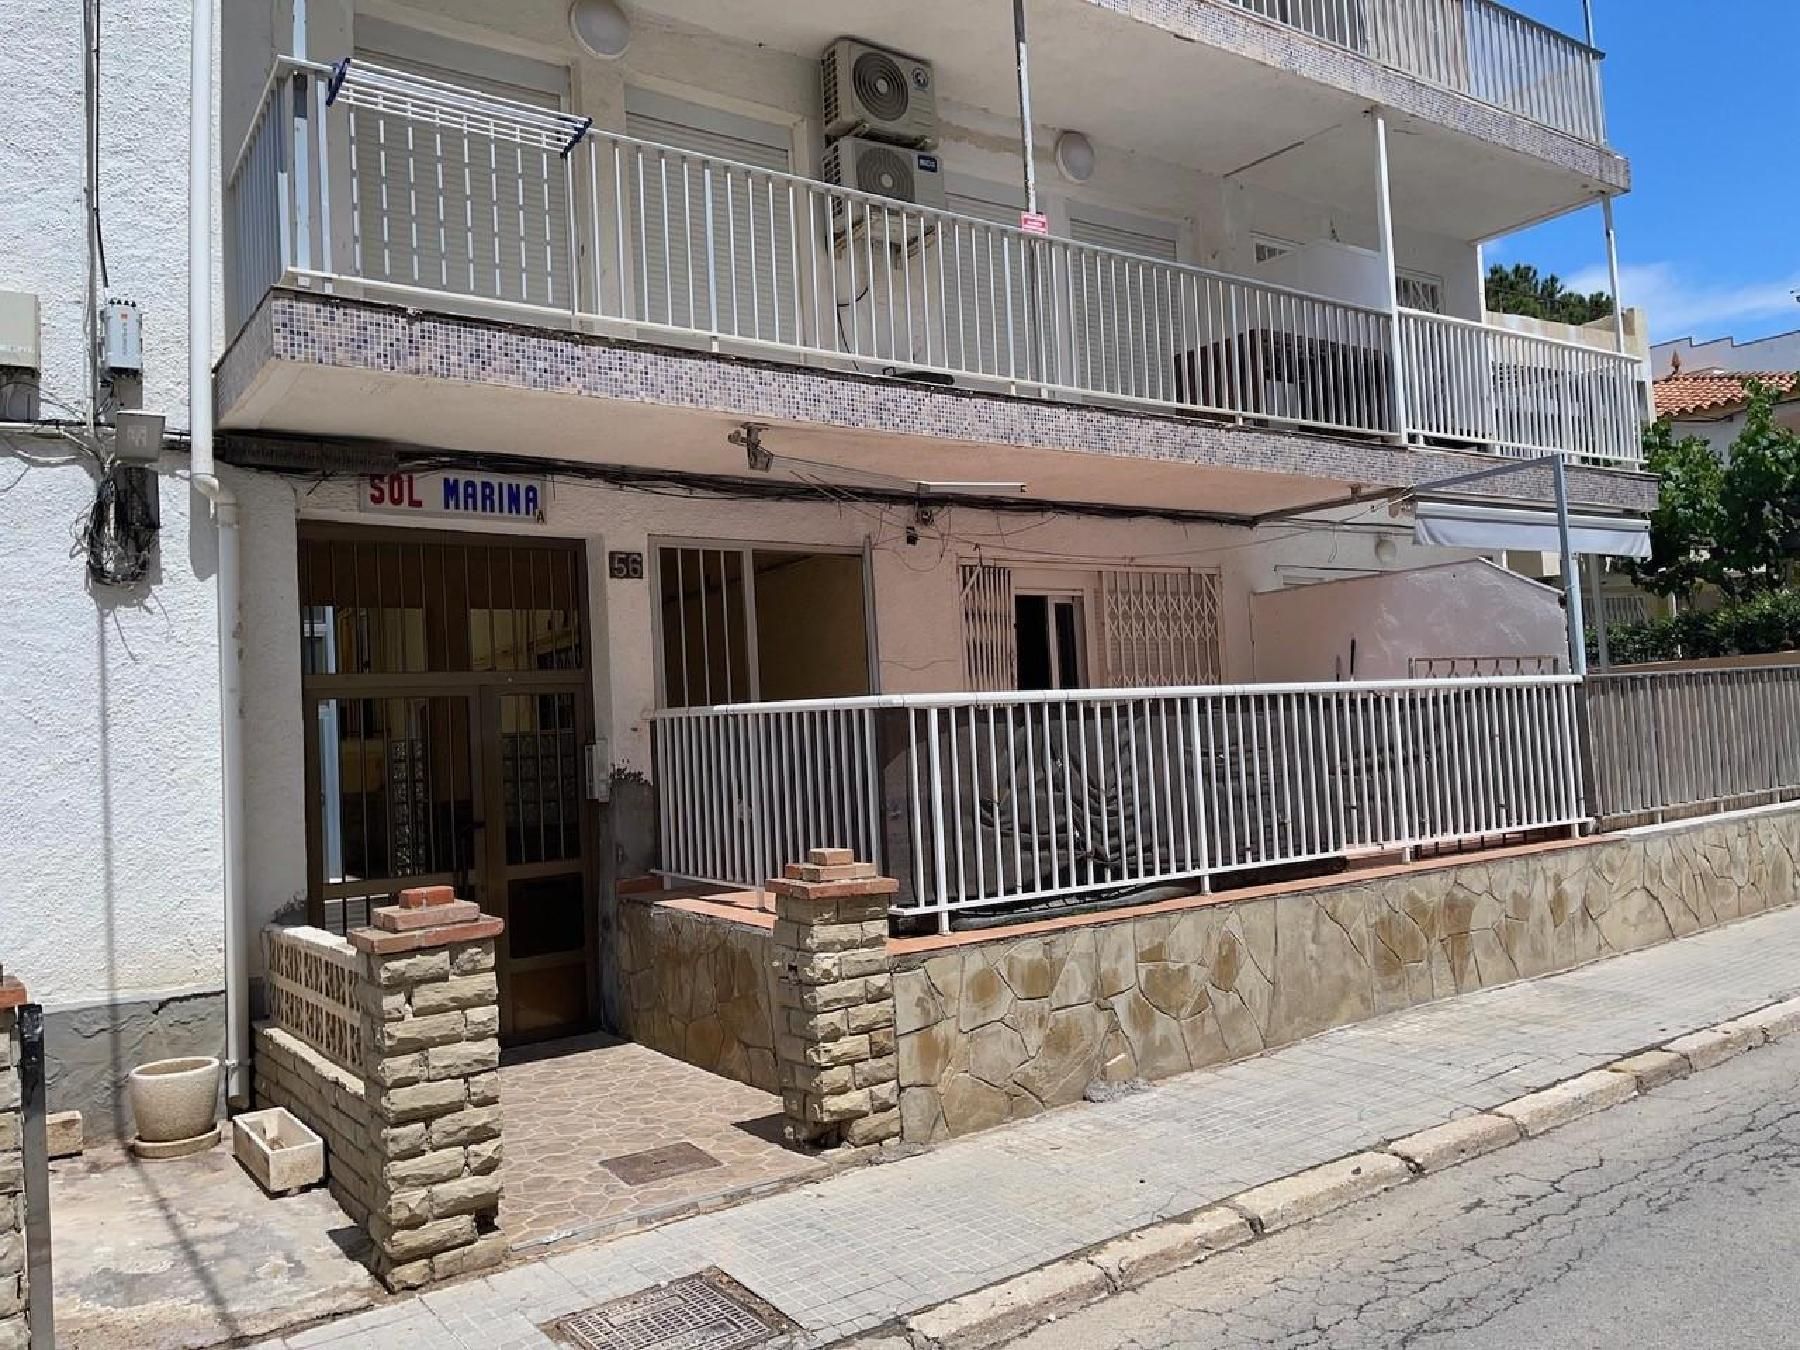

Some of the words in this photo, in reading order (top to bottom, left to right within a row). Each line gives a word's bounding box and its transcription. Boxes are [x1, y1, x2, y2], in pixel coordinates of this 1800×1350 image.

[369, 472, 423, 509] SOL
[443, 477, 538, 516] MARINA
[612, 553, 643, 577] 56
